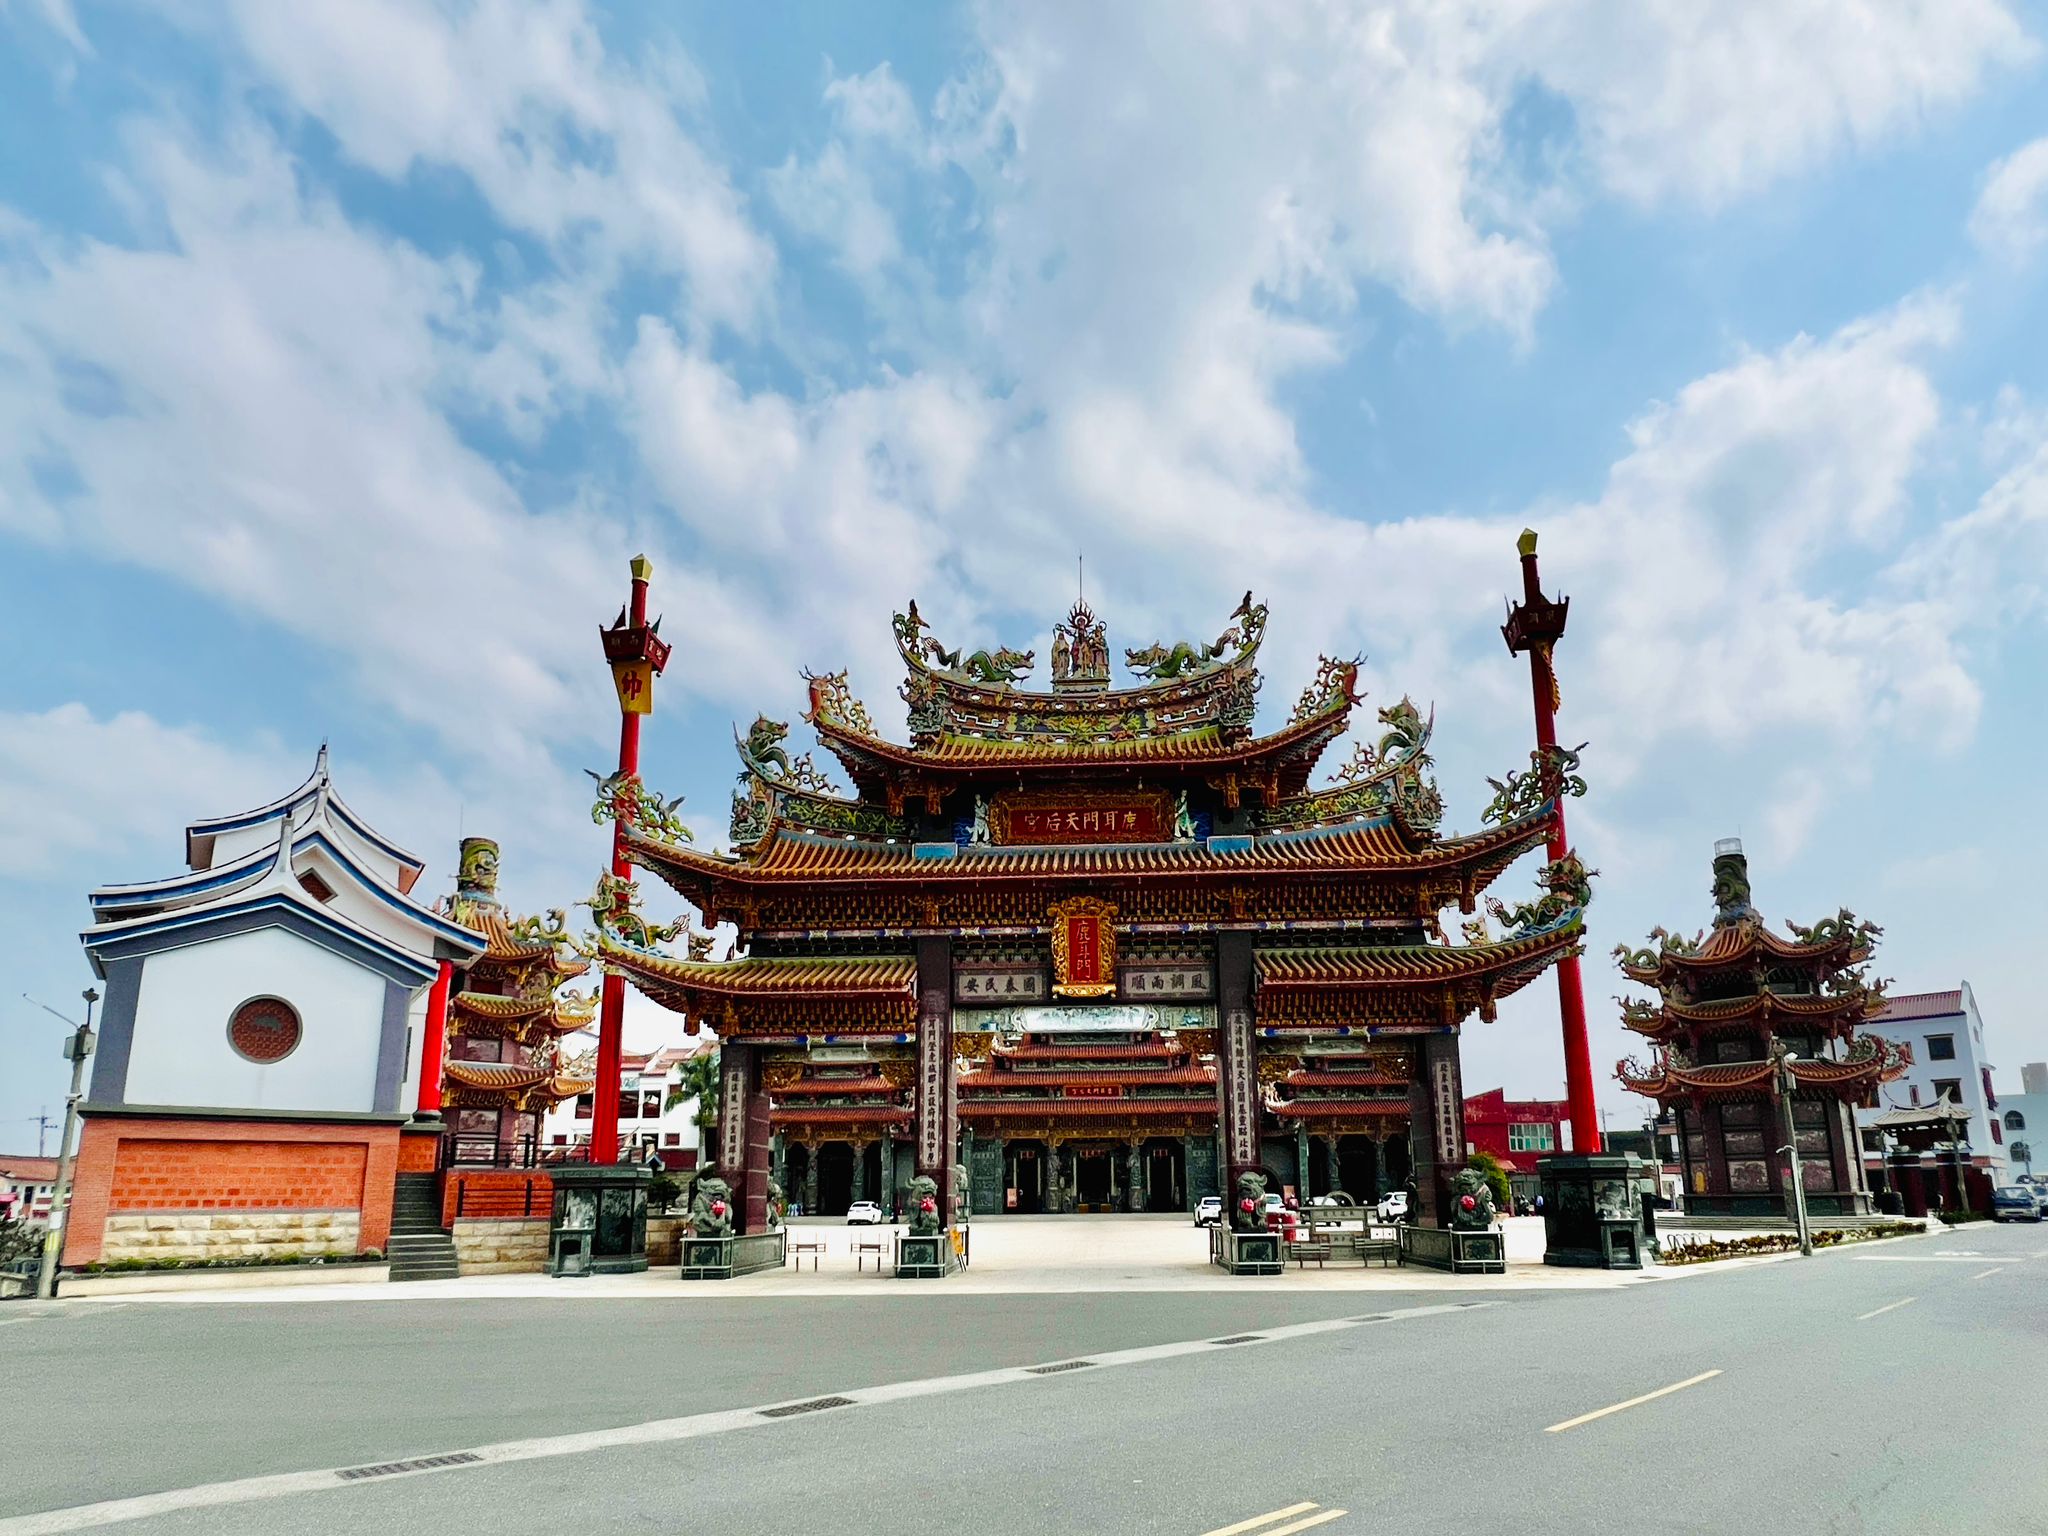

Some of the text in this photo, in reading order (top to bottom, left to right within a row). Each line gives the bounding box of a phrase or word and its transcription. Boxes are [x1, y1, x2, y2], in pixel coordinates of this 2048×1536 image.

[1024, 810, 1137, 832] 鹿耳門天后宮
[1076, 919, 1091, 979] 鹿耳門
[963, 975, 1037, 994] 國泰民安
[1131, 972, 1208, 992] 風調雨順
